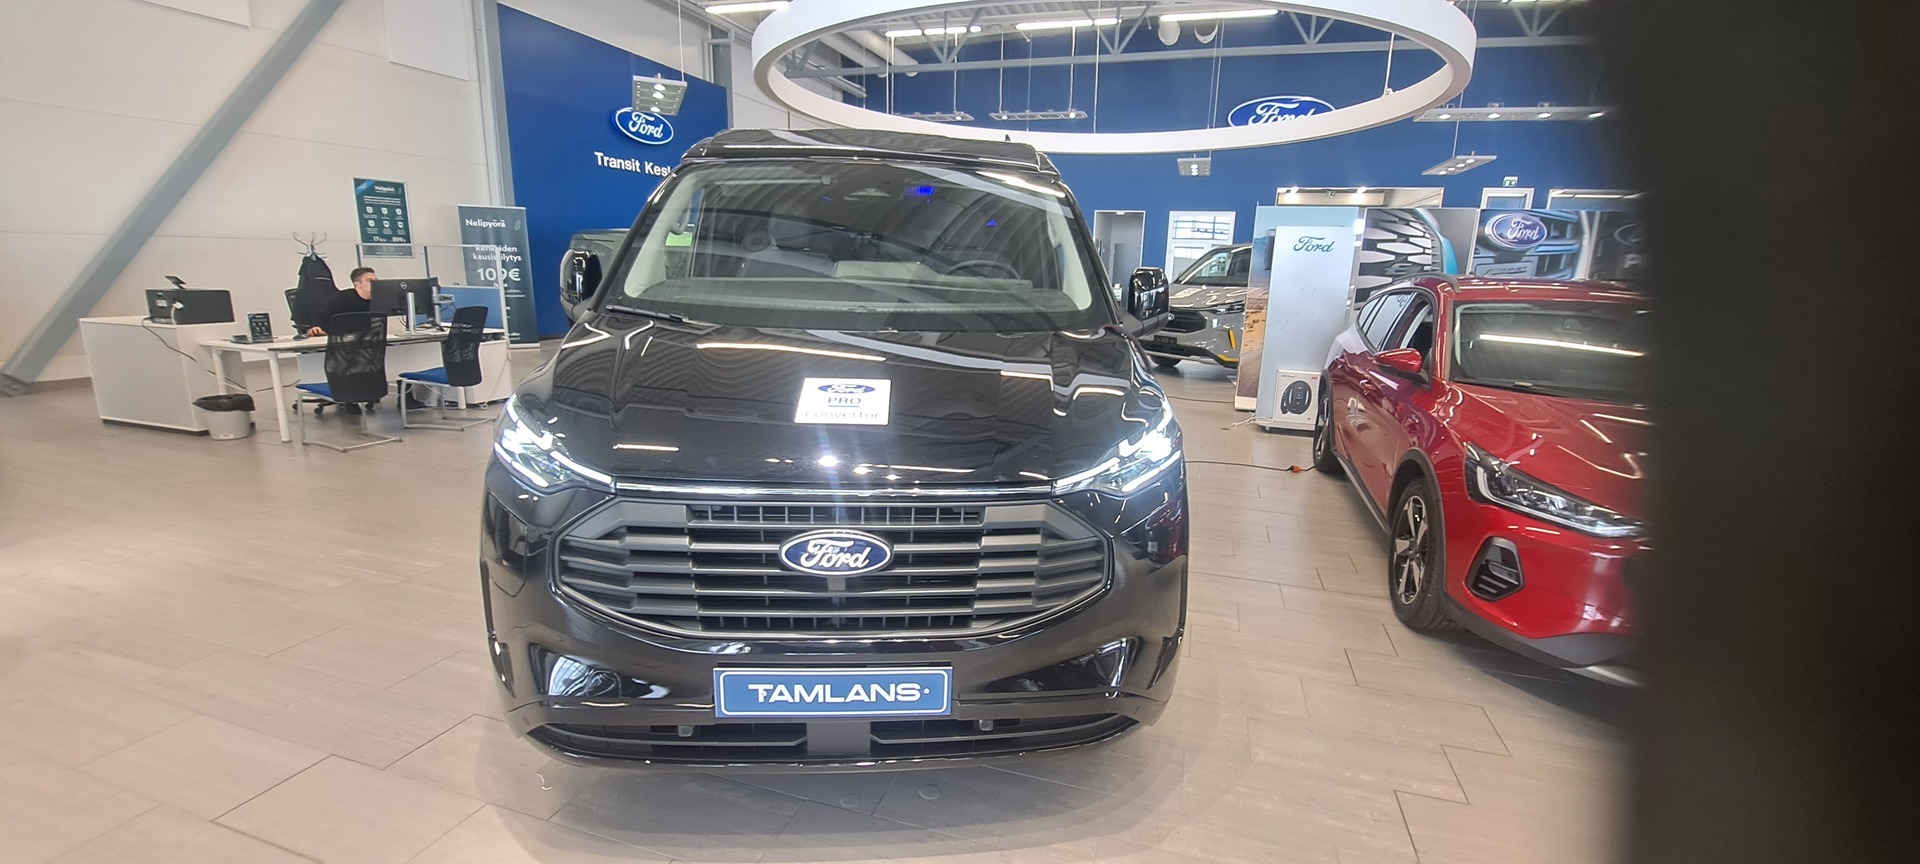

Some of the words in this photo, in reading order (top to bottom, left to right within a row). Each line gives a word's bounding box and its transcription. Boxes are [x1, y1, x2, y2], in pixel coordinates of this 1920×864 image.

[628, 111, 664, 139] Ford
[594, 151, 641, 173] Transit
[644, 161, 671, 177] Kes
[465, 218, 506, 229] Nelipyörä
[1506, 217, 1541, 241] Ford
[475, 244, 518, 253] Renkiden
[1293, 235, 1336, 253] Ford
[472, 252, 522, 263] kausisilytys
[477, 267, 521, 282] 109€
[827, 396, 861, 404] PRO
[800, 539, 870, 568] Ford
[747, 683, 922, 703] TAMLANS
